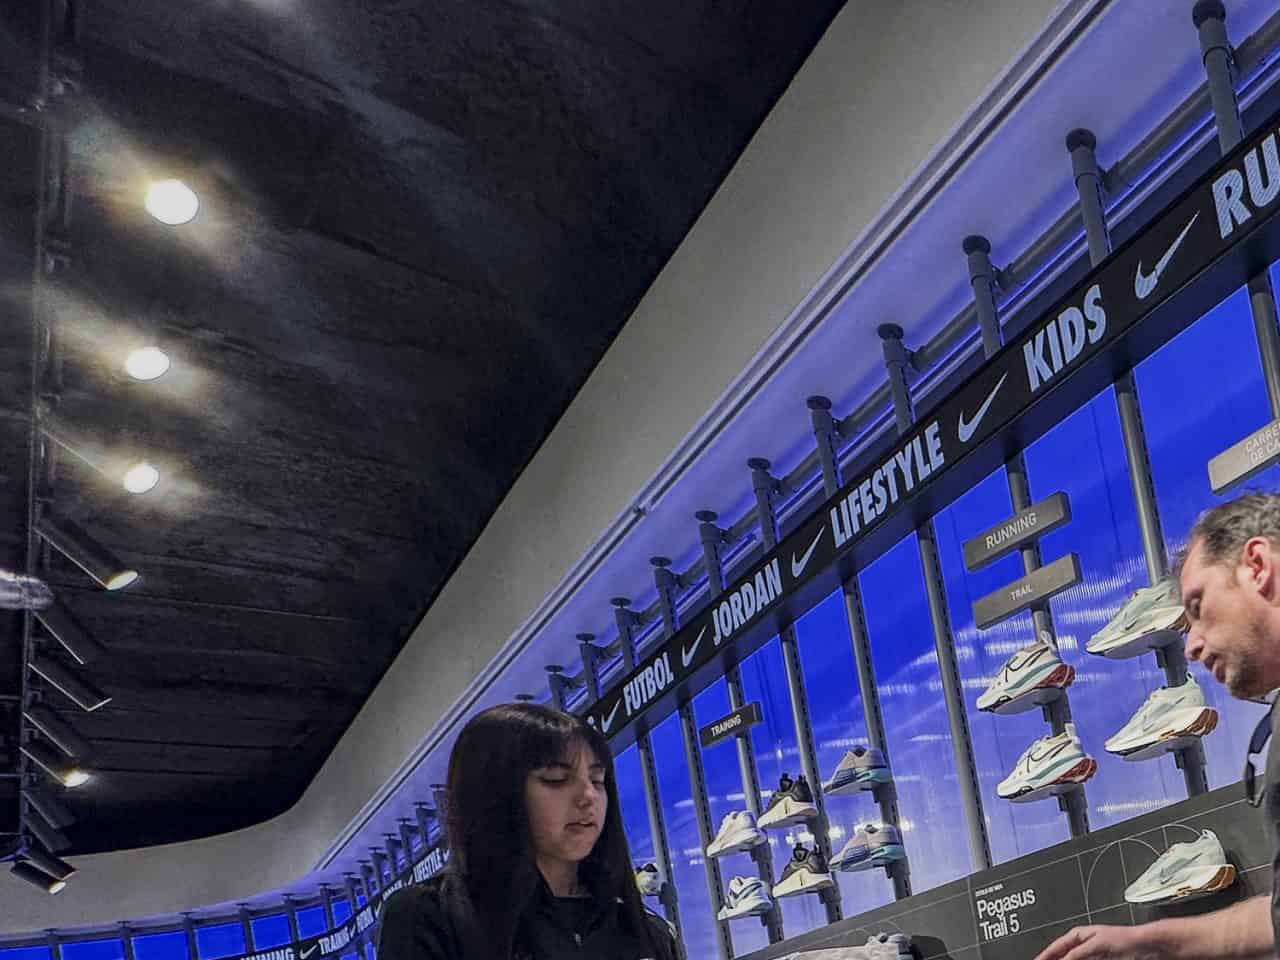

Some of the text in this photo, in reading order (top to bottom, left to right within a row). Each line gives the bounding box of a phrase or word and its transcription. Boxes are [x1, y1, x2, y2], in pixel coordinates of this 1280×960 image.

[1023, 284, 1107, 392] KIDS
[830, 421, 945, 549] LIFESTYLE
[985, 512, 1037, 549] RUNNING
[711, 557, 783, 646] JORDAN
[1010, 584, 1033, 601] TRAIL
[623, 652, 674, 716] FUTBOL
[711, 714, 742, 737] TRAINING
[977, 889, 1036, 921] Pegasus
[979, 913, 1020, 940] Trail 5
